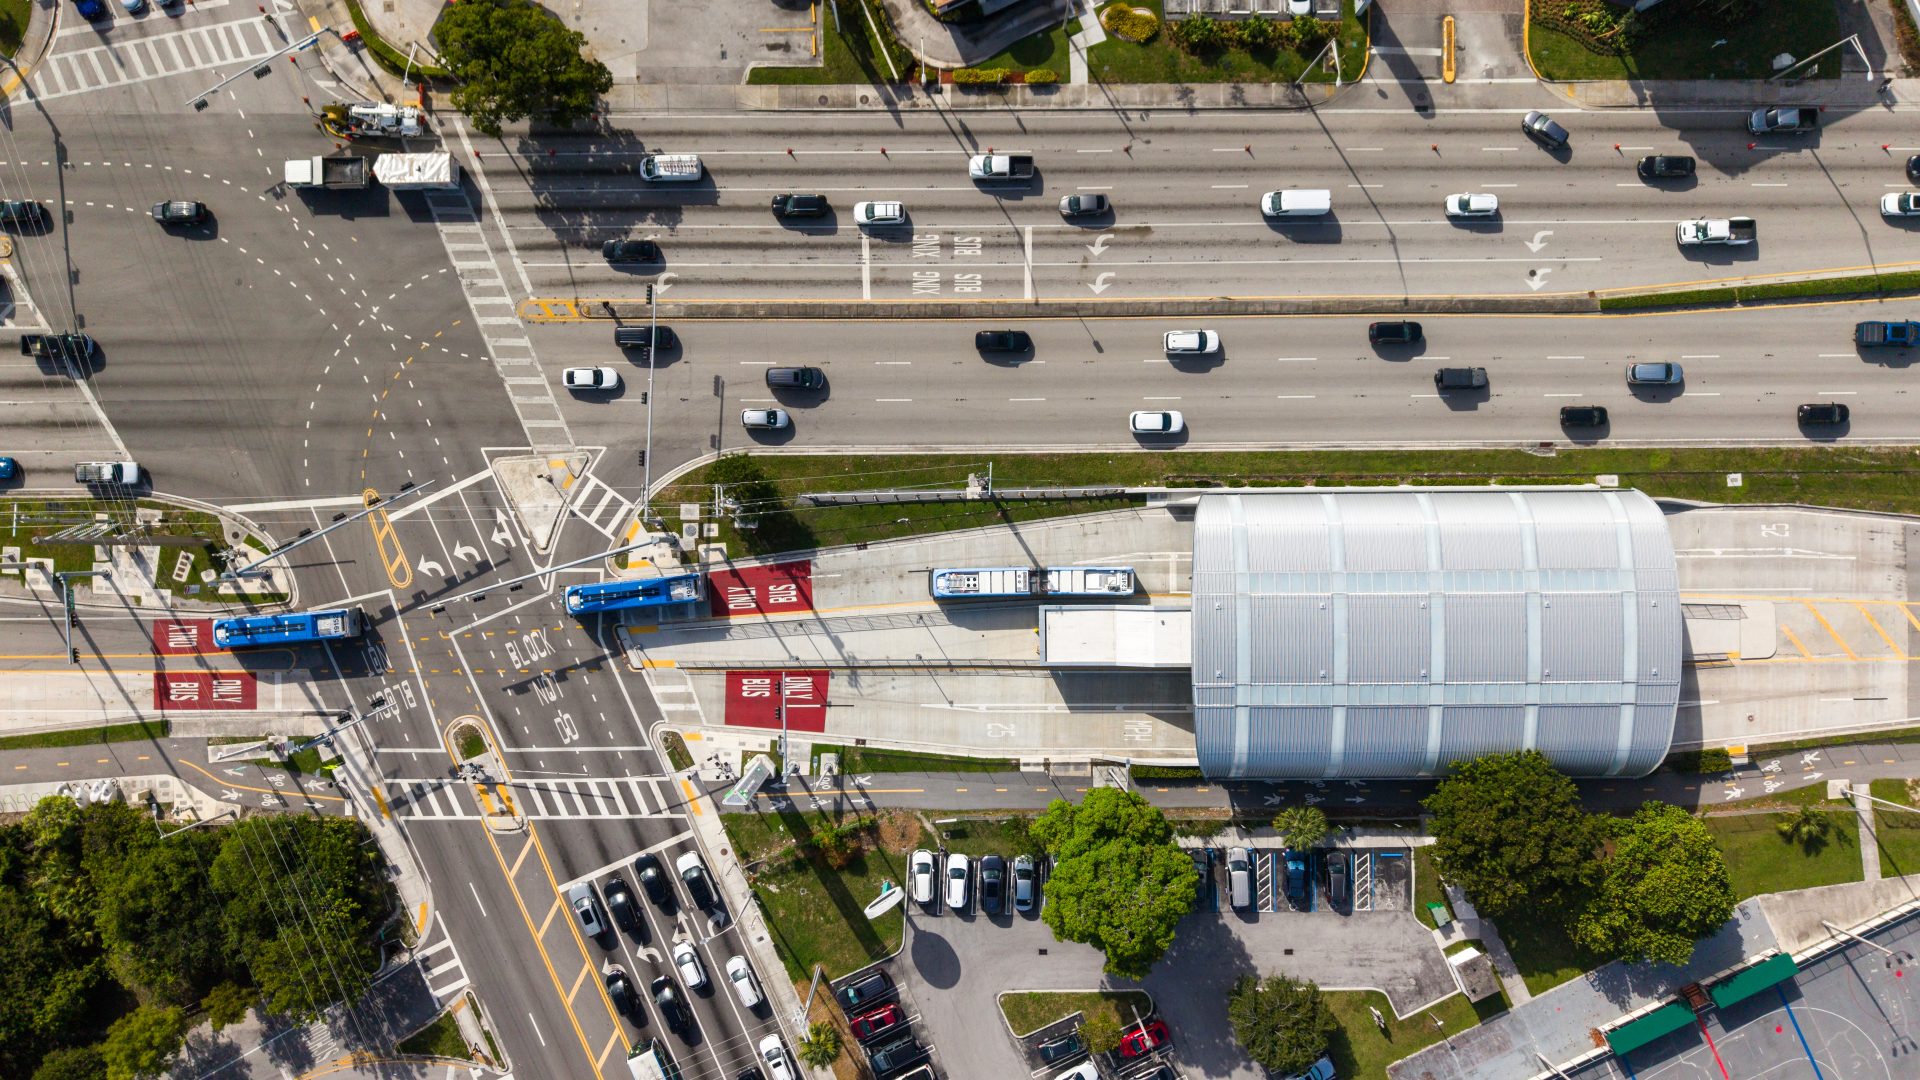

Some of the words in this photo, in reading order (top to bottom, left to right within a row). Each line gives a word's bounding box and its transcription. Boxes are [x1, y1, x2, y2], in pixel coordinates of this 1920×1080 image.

[912, 234, 940, 258] XING
[954, 236, 982, 255] BUS
[912, 271, 940, 295] XING
[954, 273, 982, 292] BUS
[1760, 523, 1790, 538] 25
[728, 586, 757, 609] ONLY
[768, 583, 798, 604] BUS
[168, 624, 198, 648] ONLY
[504, 627, 556, 670] BLOCK
[169, 682, 199, 701] BUS
[213, 679, 242, 703] ONLY
[529, 671, 564, 707] NOT
[741, 678, 771, 697] BUS
[784, 676, 813, 700] ONLY
[553, 713, 580, 745] DO
[986, 722, 1016, 738] 25
[1123, 719, 1153, 741] MPH
